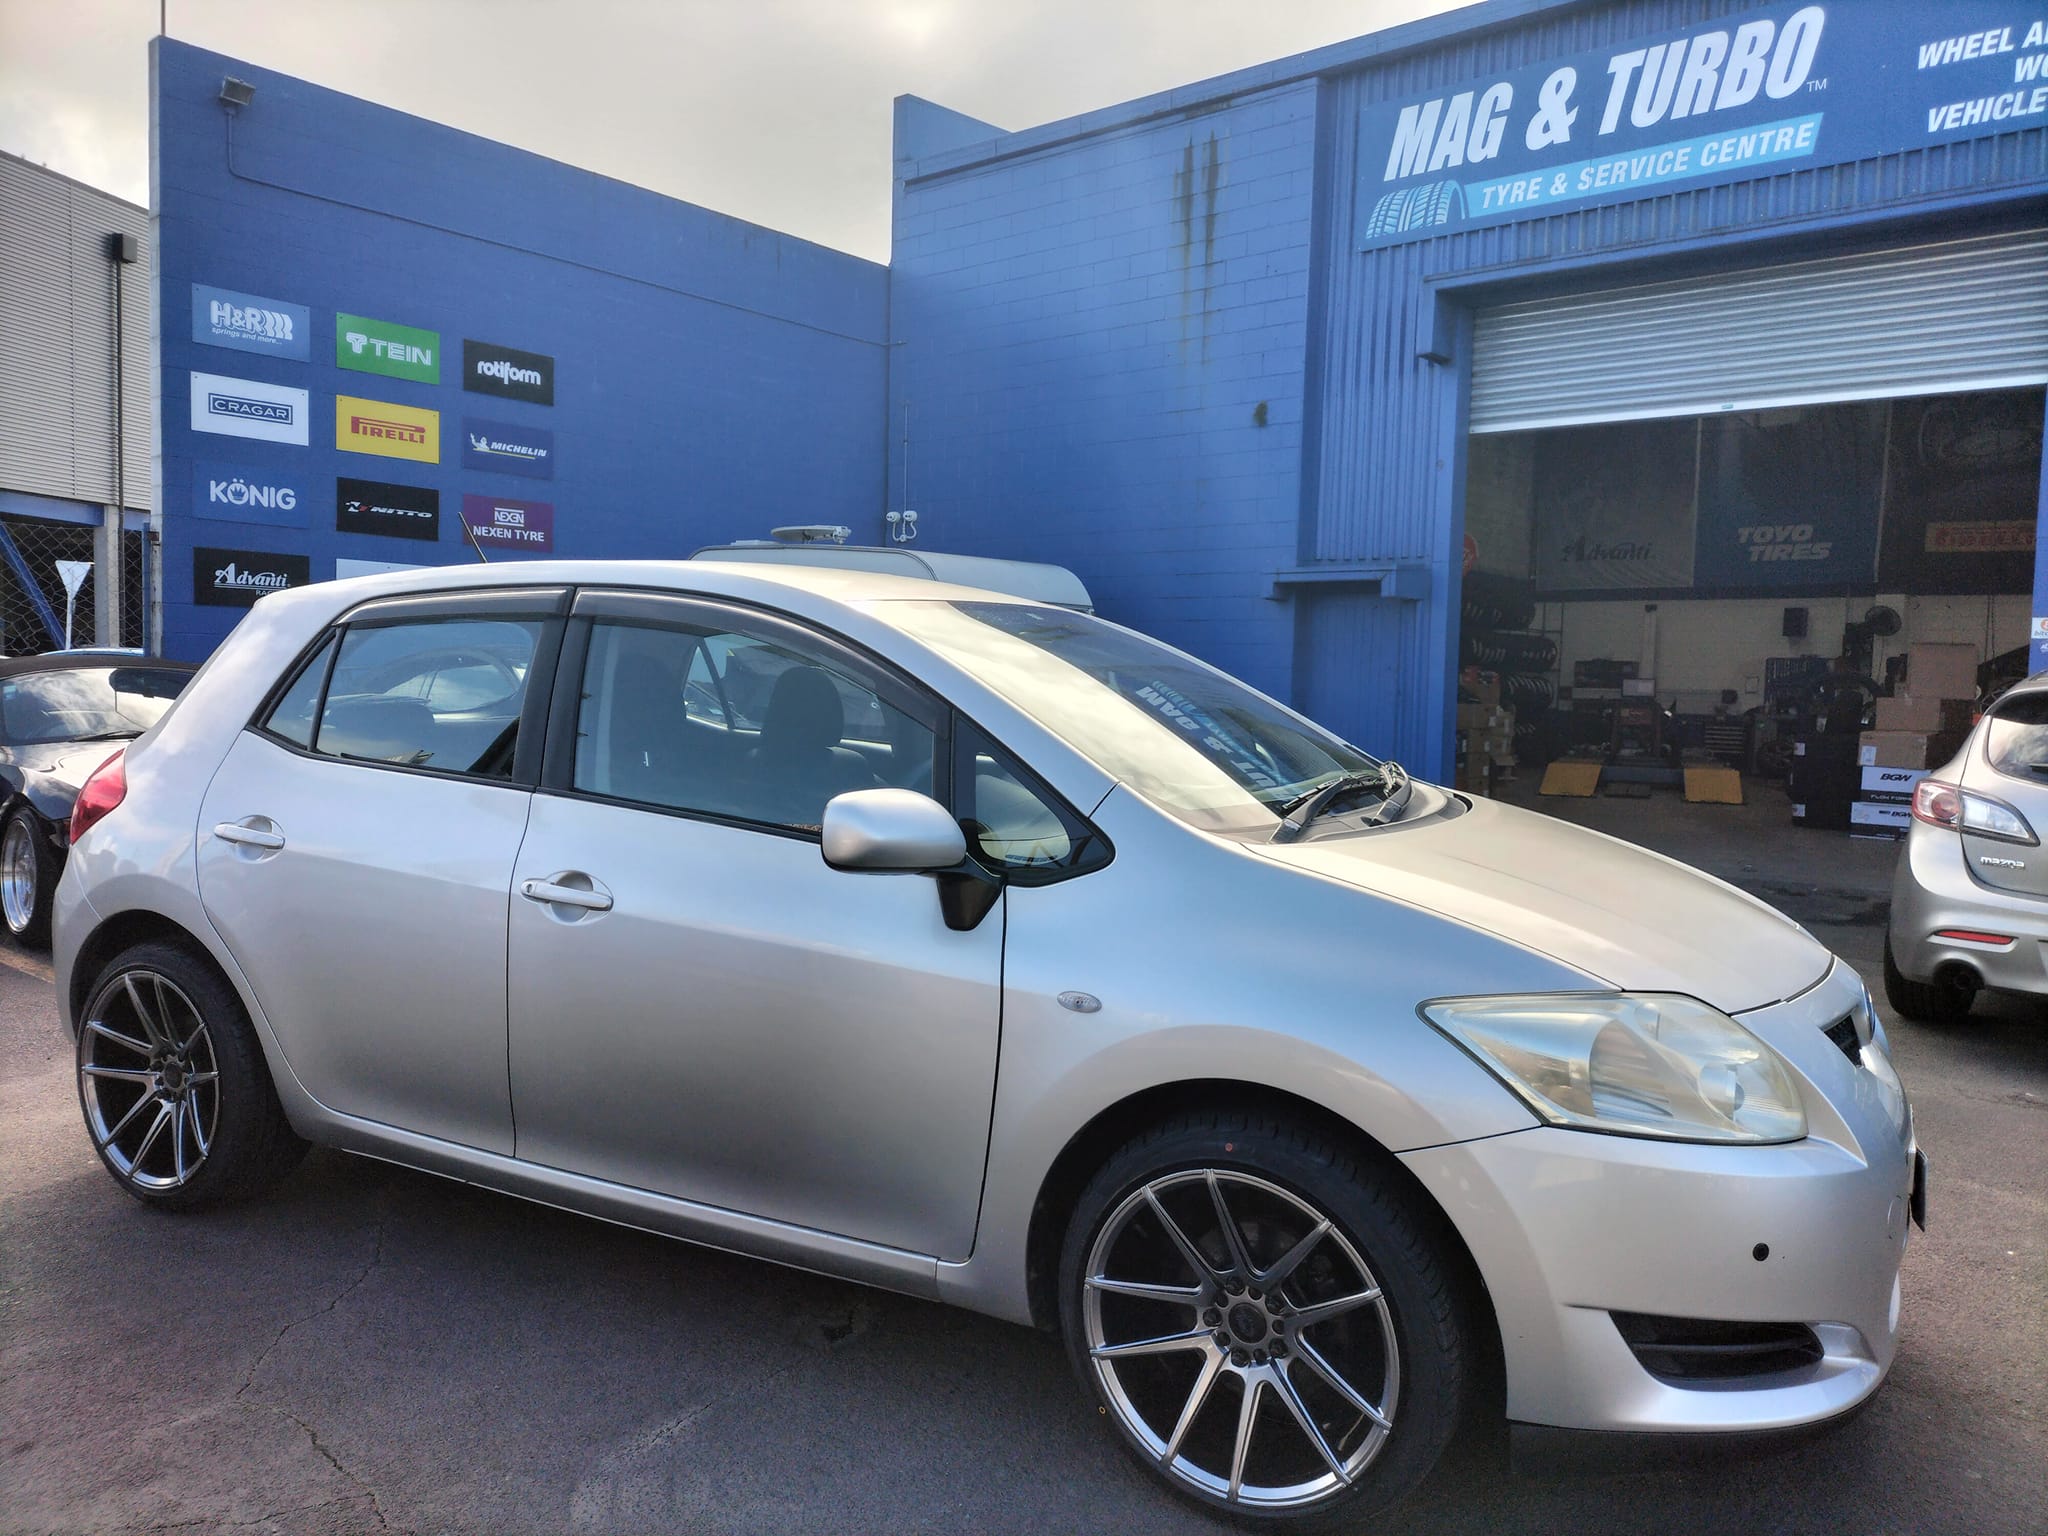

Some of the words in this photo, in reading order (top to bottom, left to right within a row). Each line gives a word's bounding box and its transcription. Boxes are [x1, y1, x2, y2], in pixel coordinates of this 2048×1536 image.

[1918, 26, 2014, 70] WHEEL
[2021, 20, 2048, 48] A
[1383, 82, 1513, 182] MAG
[1525, 66, 1580, 151] &
[1598, 5, 1826, 135] TURBO
[1927, 86, 2048, 133] VEHICLE
[1482, 177, 1543, 209] TYRE
[1550, 172, 1569, 196] &
[1577, 147, 1692, 191] SERVICE
[1701, 122, 1815, 167] CENTRE
[212, 326, 241, 338] springs
[242, 331, 257, 341] and
[367, 338, 432, 366] TEIN
[477, 360, 542, 386] rotiform
[214, 400, 288, 420] CRAGAR
[350, 415, 426, 445] PIRELLI
[490, 441, 548, 458] MICHELIN
[209, 478, 297, 511] KÖNIG
[370, 506, 433, 518] NITTO
[494, 509, 525, 525] NEXEN
[473, 525, 512, 539] NEXEN
[514, 529, 545, 542] TYRE
[1738, 525, 1814, 543] TOYO
[1749, 542, 1833, 562] TIRES
[214, 562, 289, 588] Advanti
[1880, 773, 1912, 781] BGW
[1980, 856, 2025, 869] mazda
